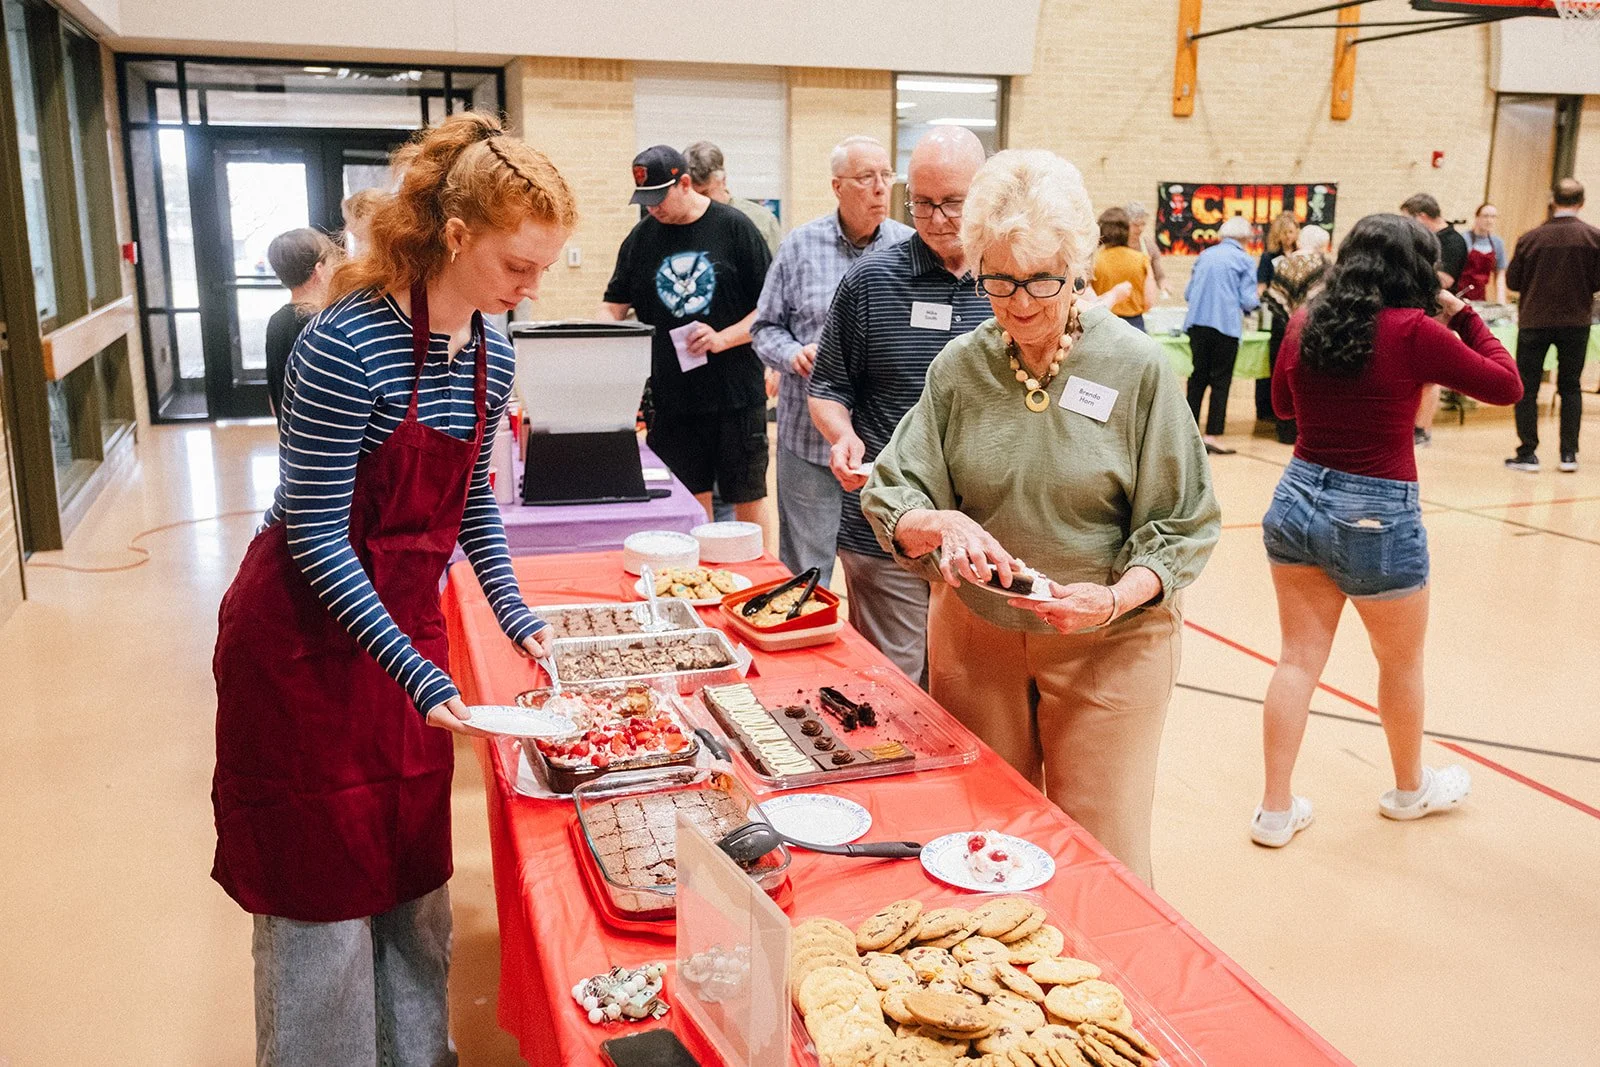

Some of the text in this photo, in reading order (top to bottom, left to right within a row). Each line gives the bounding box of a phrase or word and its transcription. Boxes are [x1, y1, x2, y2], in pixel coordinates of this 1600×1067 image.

[1191, 185, 1308, 225] CHILI
[1079, 388, 1101, 400] Brenda
[1079, 396, 1095, 407] Horn
